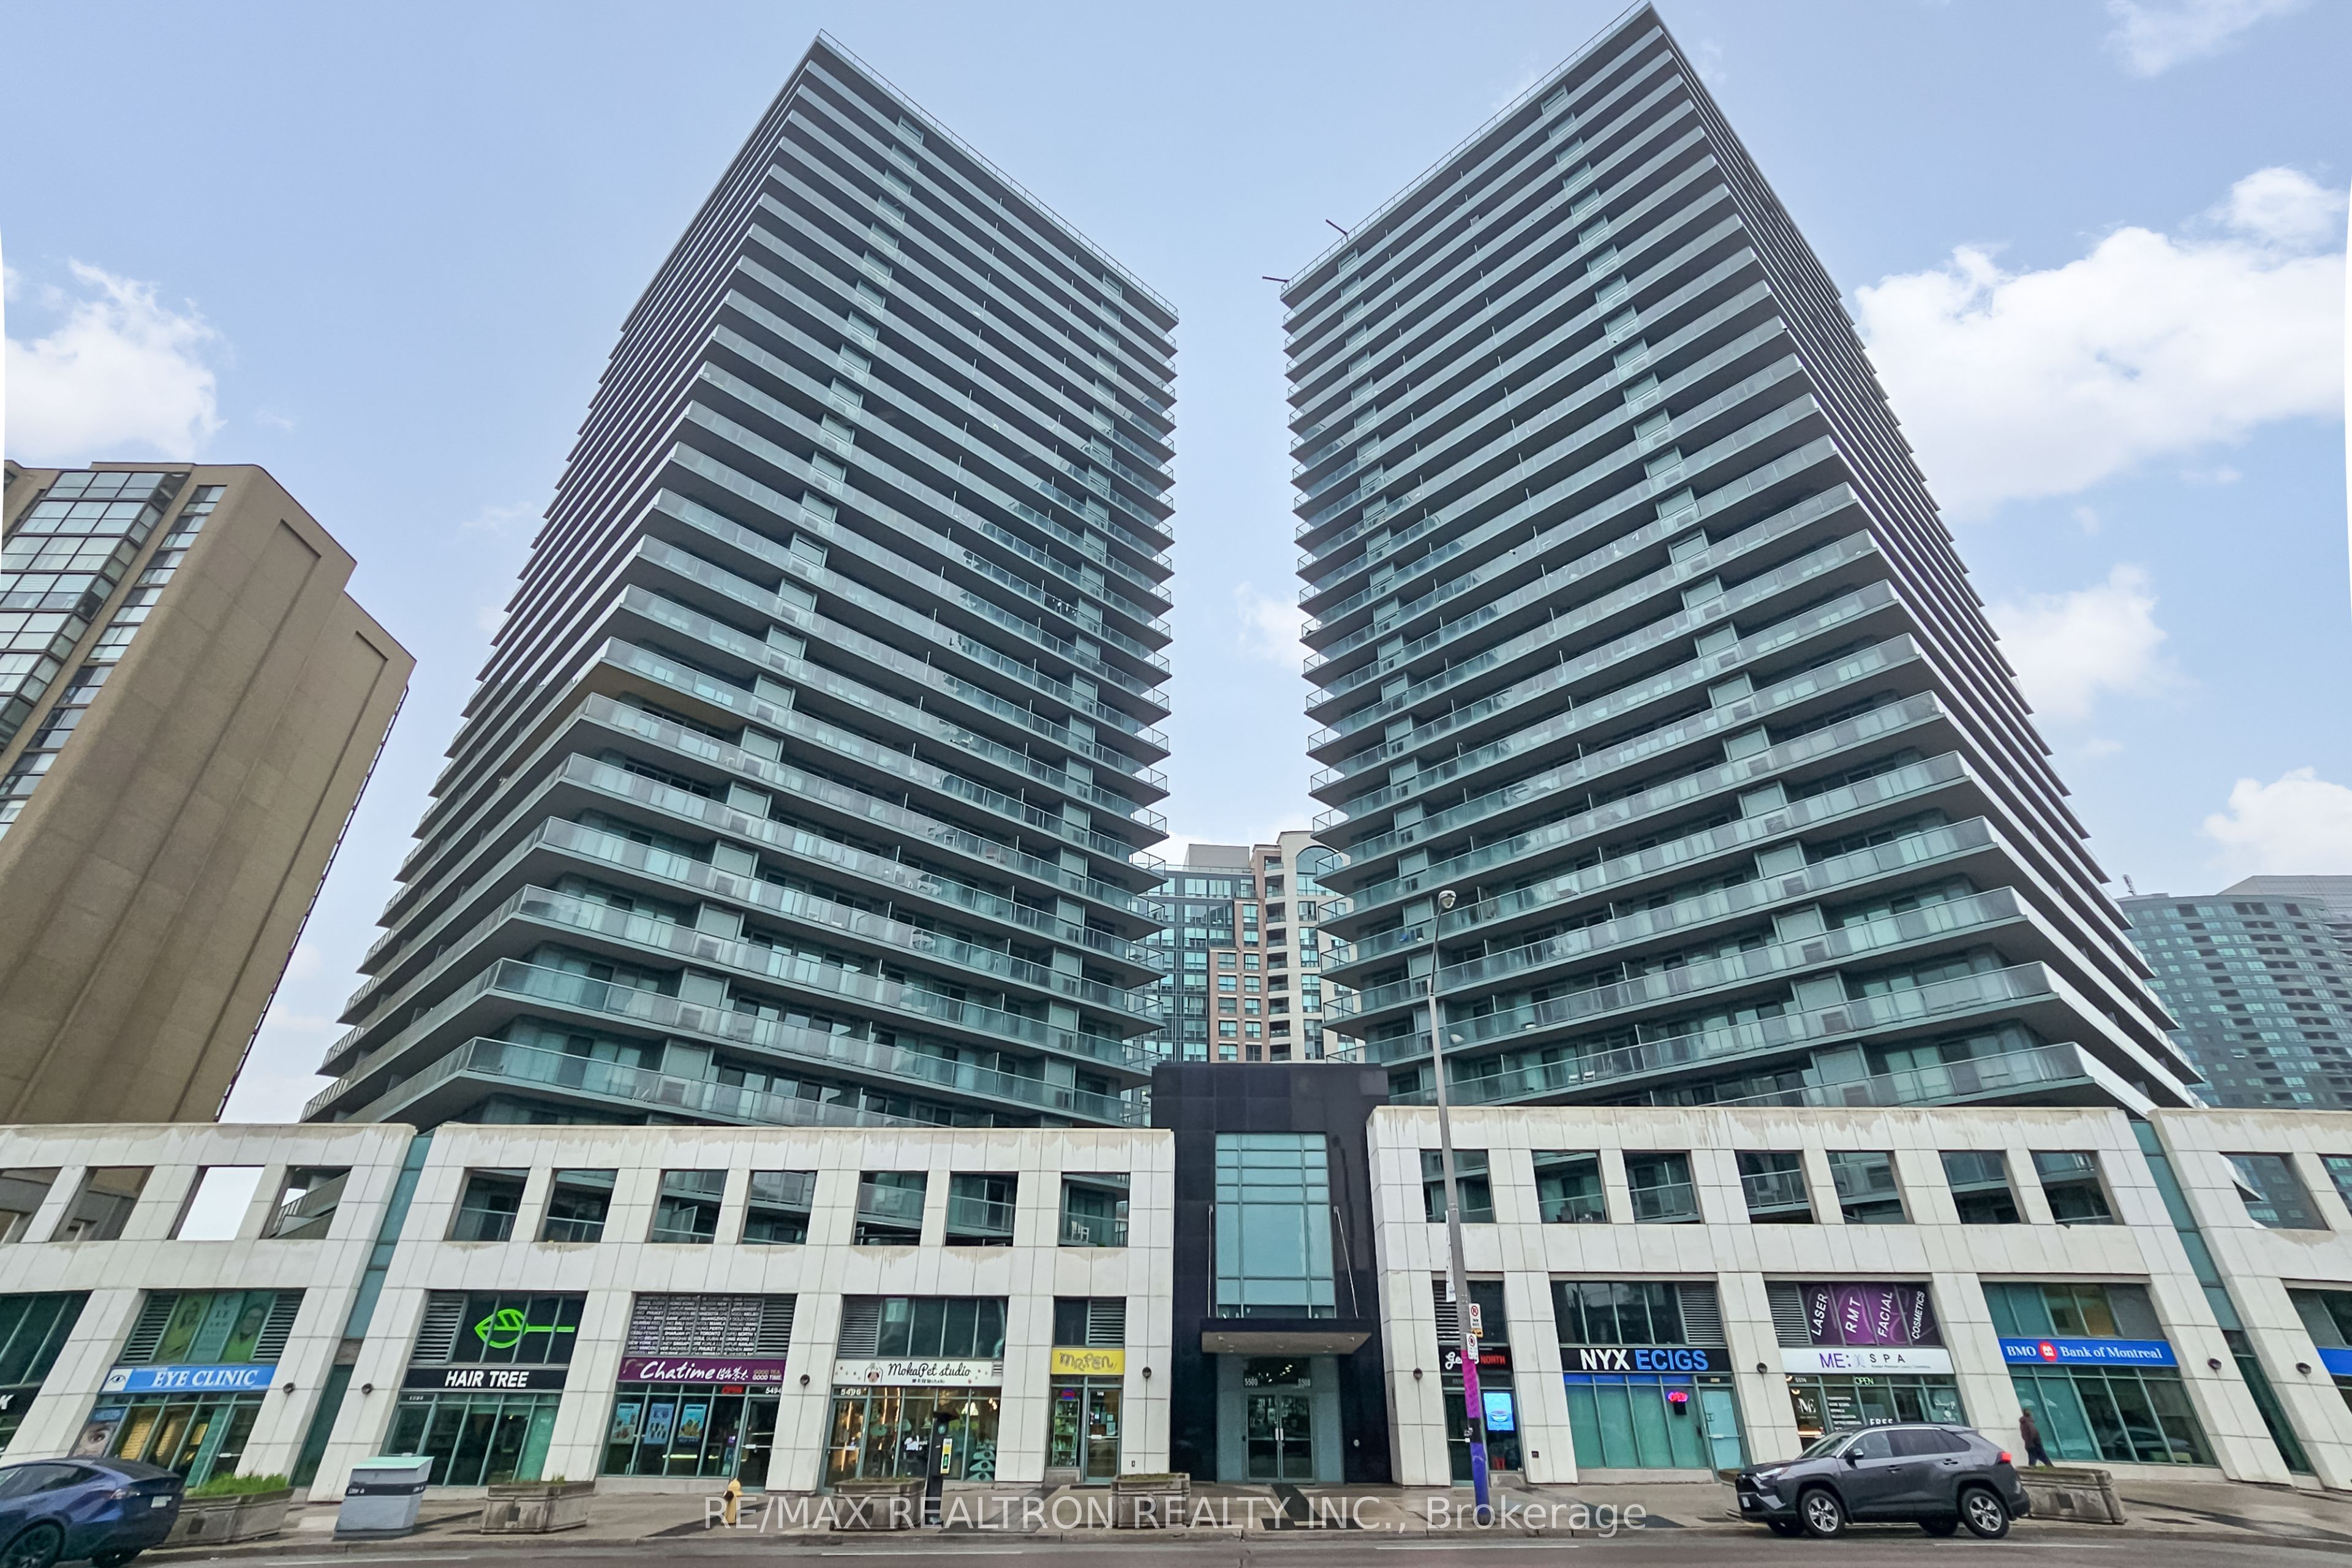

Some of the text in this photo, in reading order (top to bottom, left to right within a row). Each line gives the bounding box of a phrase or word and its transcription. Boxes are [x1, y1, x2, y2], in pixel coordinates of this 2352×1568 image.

[1811, 1293, 1828, 1336] LASER
[1845, 1297, 1861, 1333] RMT
[1877, 1292, 1893, 1338] FACIAL
[1912, 1291, 1926, 1340] COSMETICS
[1480, 1354, 1506, 1365] NORTH
[2006, 1346, 2036, 1356] BMO
[2059, 1346, 2163, 1359] Bank of Montreal
[1580, 1349, 1709, 1371] NYX ECIGS
[151, 1370, 258, 1387] EYE CLINIC
[640, 1360, 716, 1381] Chatime
[888, 1362, 971, 1378] MokaPet studio
[445, 1371, 529, 1387] HAIR TREE
[1855, 1377, 1874, 1385] OPEN
